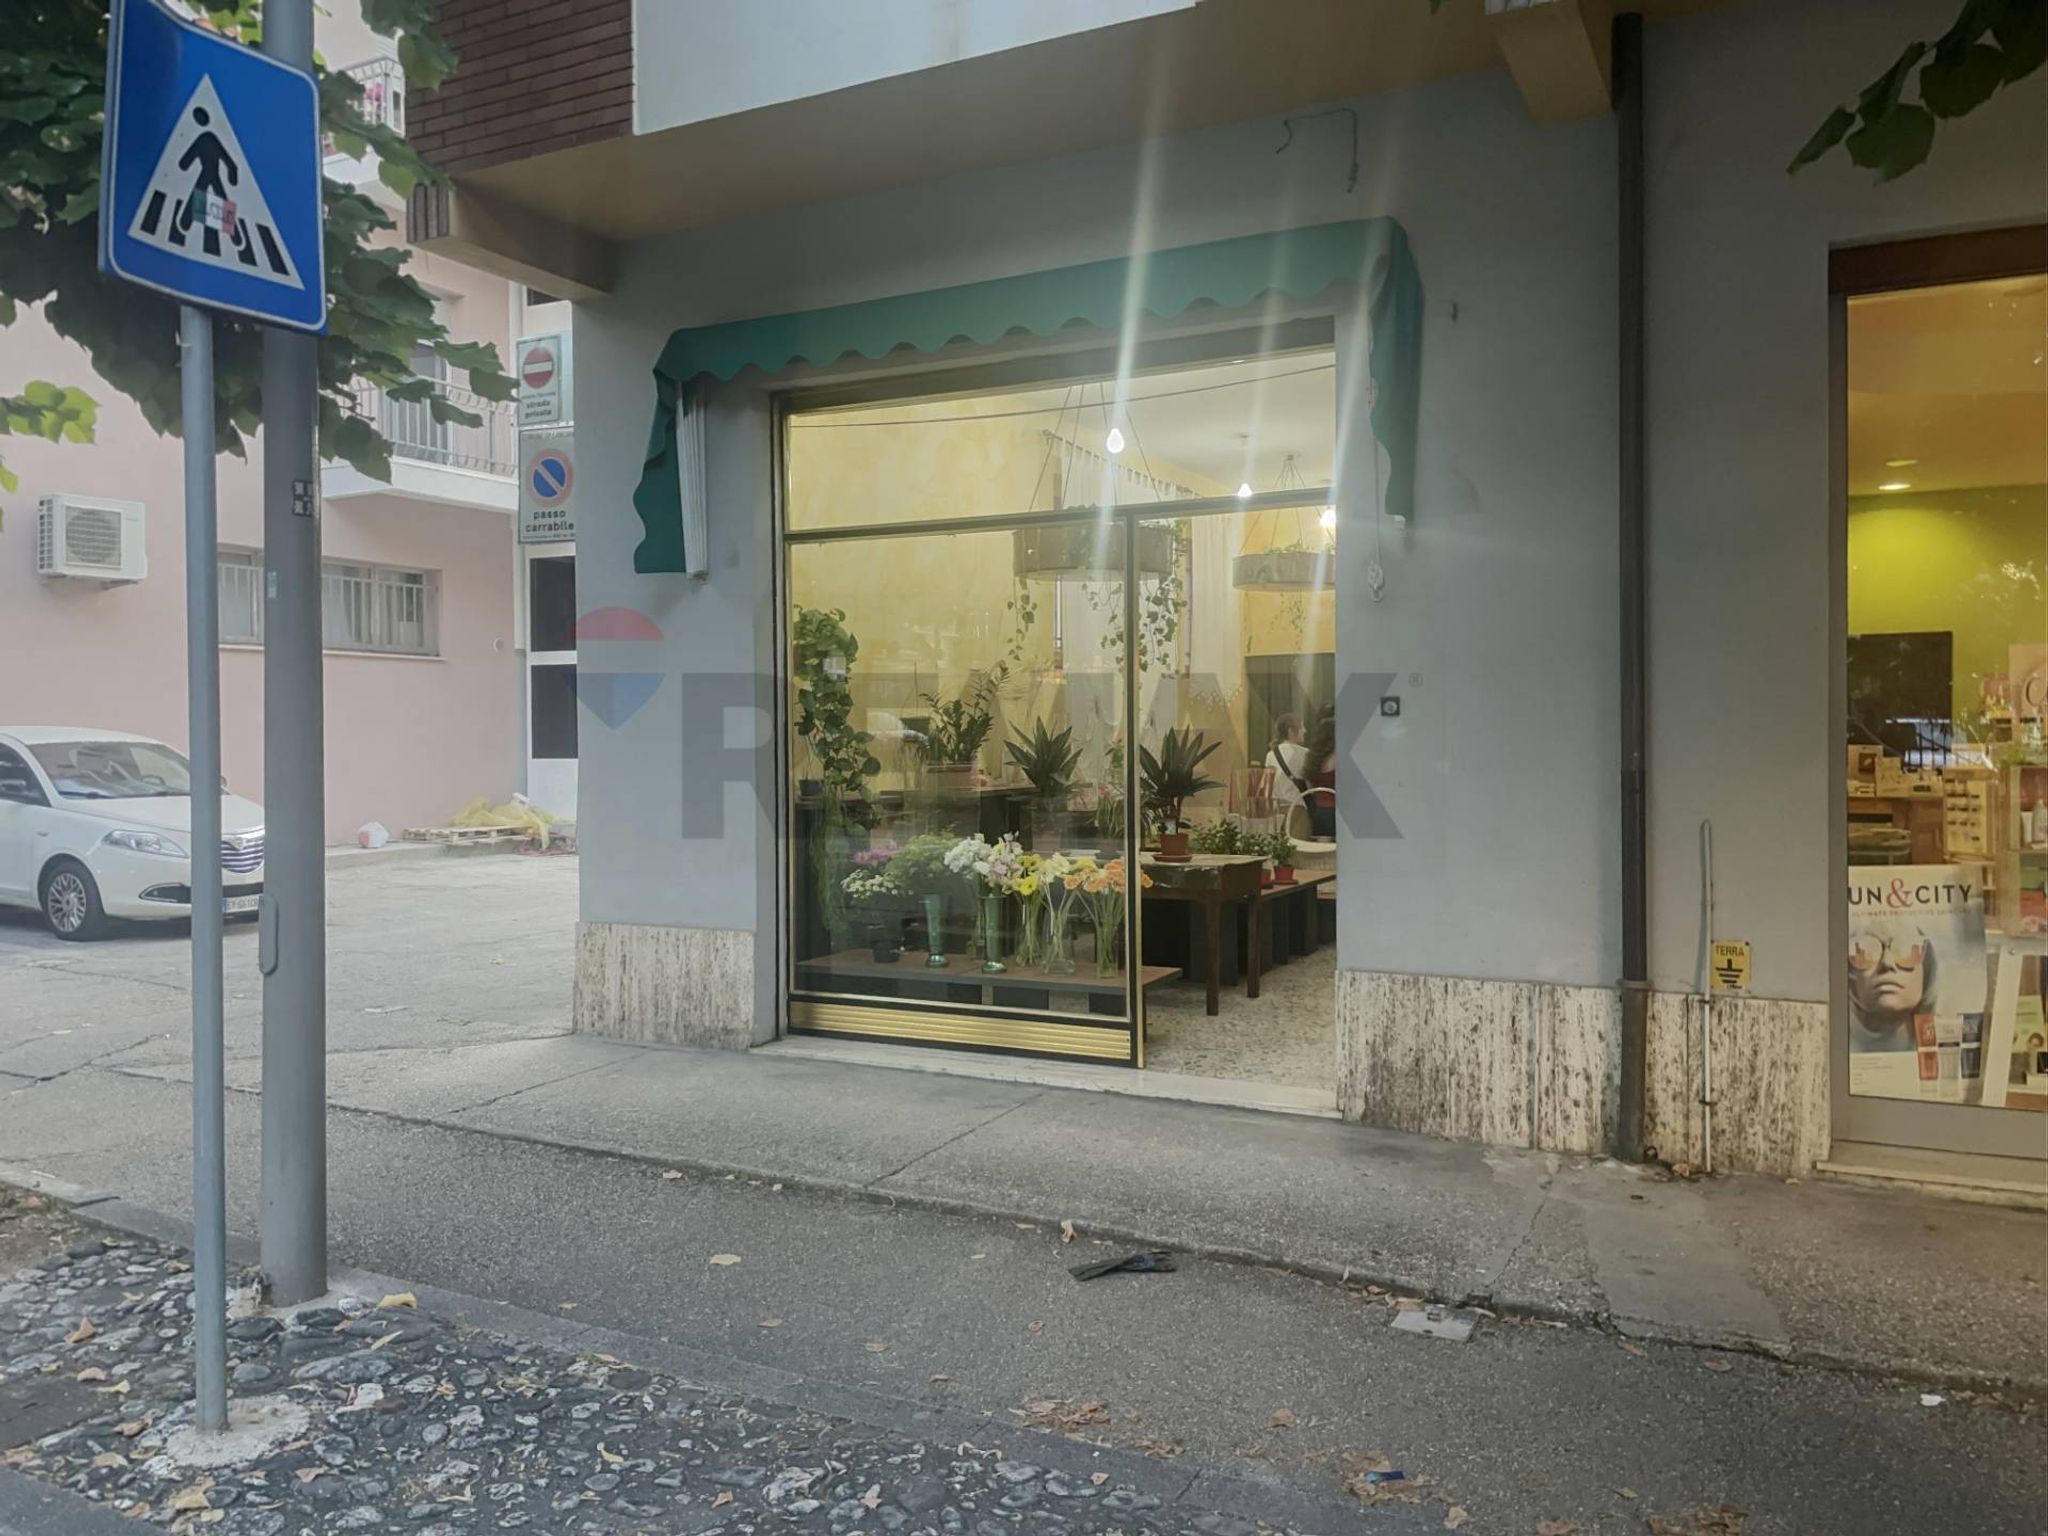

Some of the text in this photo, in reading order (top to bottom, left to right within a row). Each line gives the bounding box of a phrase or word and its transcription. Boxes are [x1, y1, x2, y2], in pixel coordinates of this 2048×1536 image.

[533, 510, 566, 521] passo
[525, 520, 574, 532] carrabile
[1715, 944, 1745, 957] TERRA
